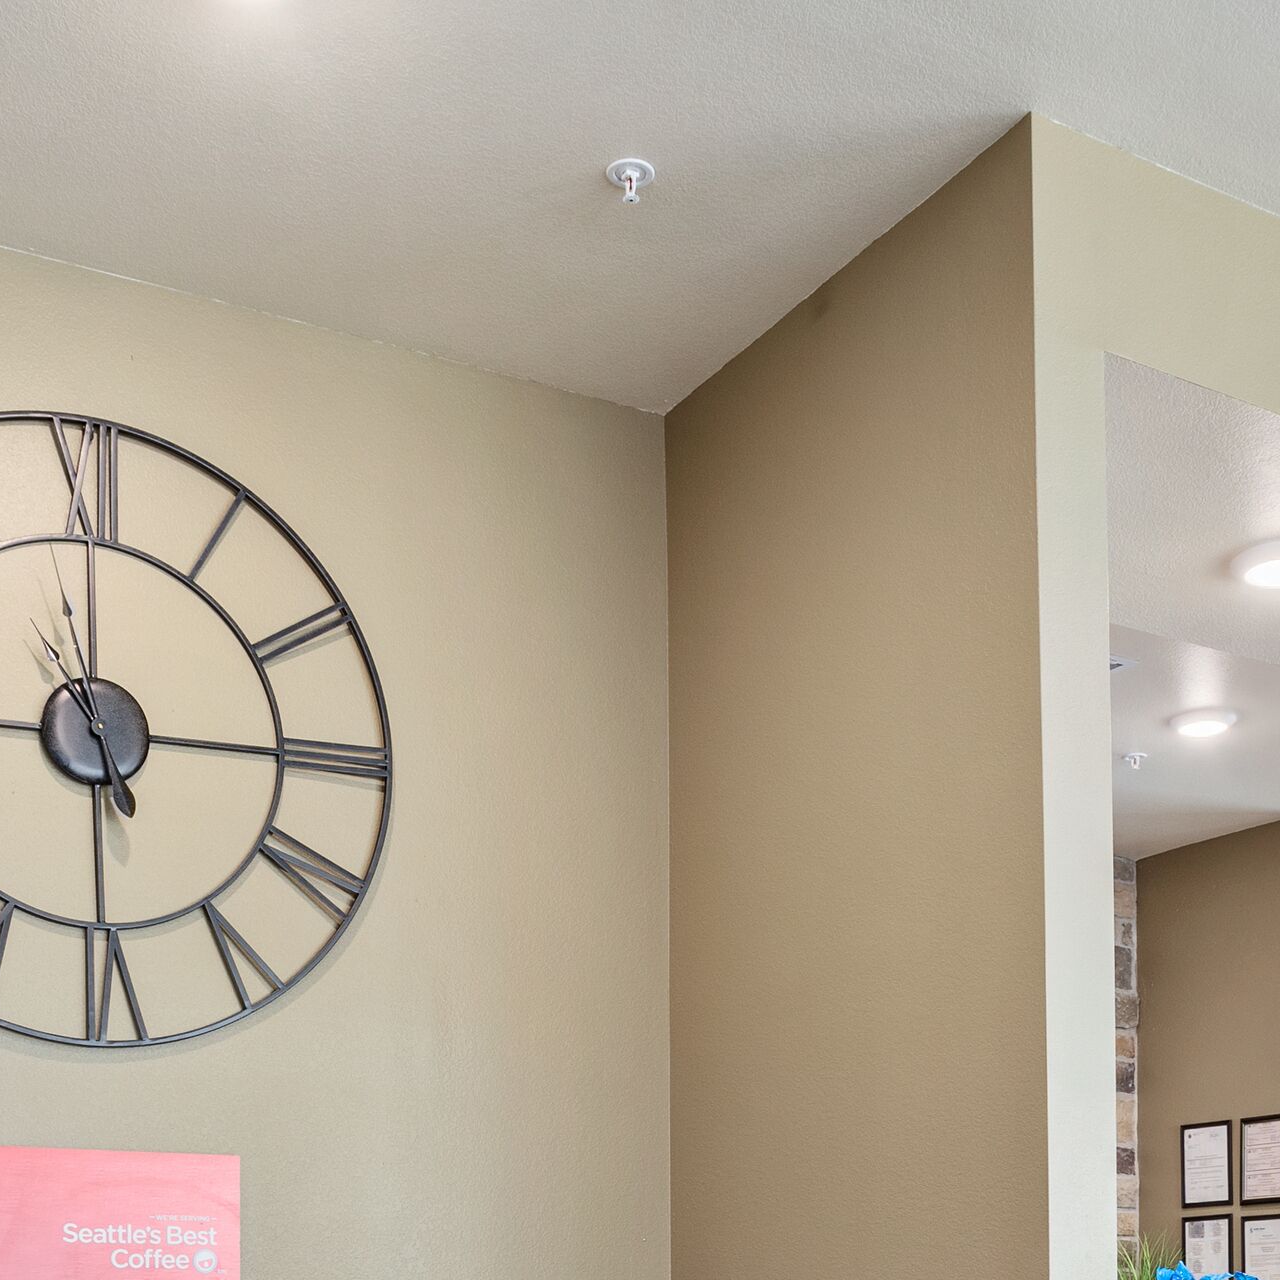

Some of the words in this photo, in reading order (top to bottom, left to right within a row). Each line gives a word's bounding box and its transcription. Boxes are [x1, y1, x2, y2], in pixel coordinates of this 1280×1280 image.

[62, 1223, 161, 1245] Seattle's
[166, 1225, 217, 1246] Best
[111, 1249, 189, 1269] Coffee
